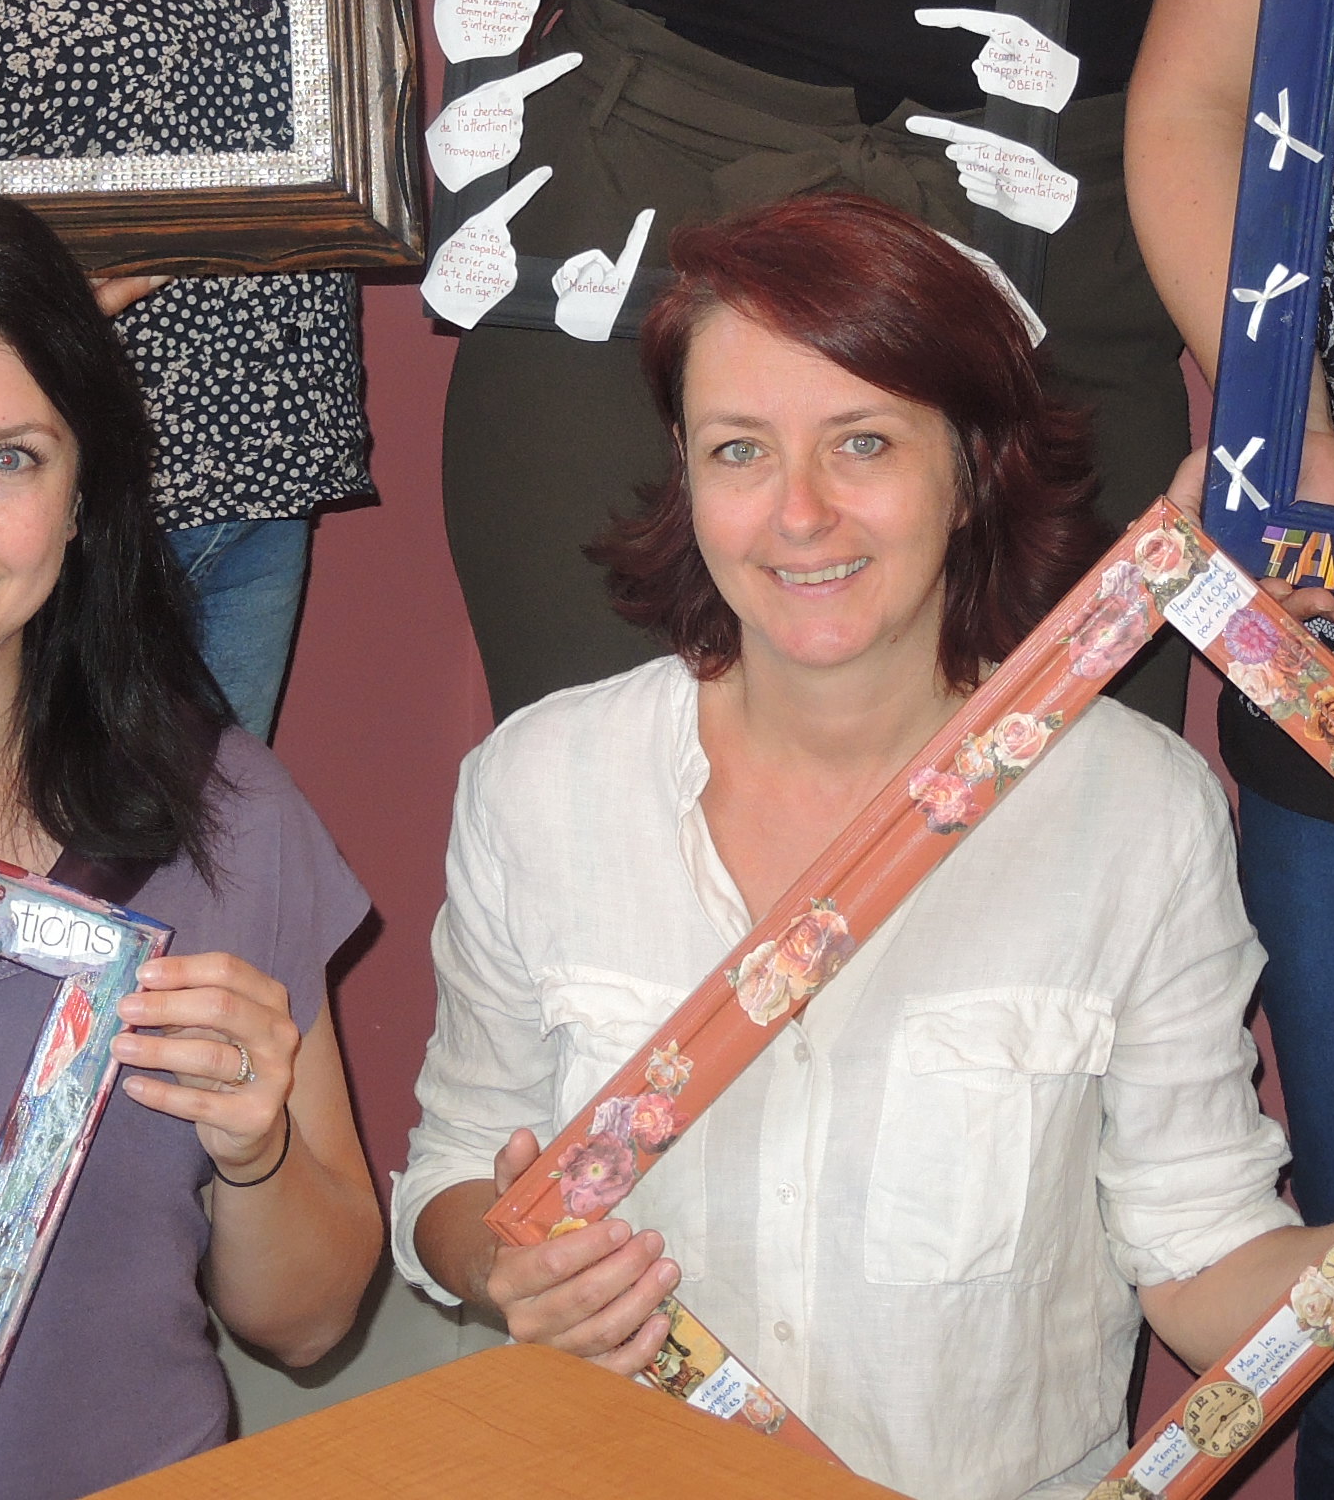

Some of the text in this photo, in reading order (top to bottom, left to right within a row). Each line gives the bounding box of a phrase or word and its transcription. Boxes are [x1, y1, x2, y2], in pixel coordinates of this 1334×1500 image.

[455, 6, 498, 21] comment
[1017, 38, 1030, 48] es
[1029, 51, 1041, 64] tu
[473, 105, 513, 117] cherches
[439, 119, 452, 134] de
[994, 148, 1036, 166] devrais
[965, 161, 1068, 186] avoir de meilleures
[450, 239, 507, 259] pas capable
[443, 248, 500, 273] de crier ou
[437, 263, 511, 289] de te défendre
[444, 280, 451, 293] à
[454, 281, 474, 296] ton
[1258, 1336, 1277, 1350] les
[1152, 1438, 1182, 1464] temps
